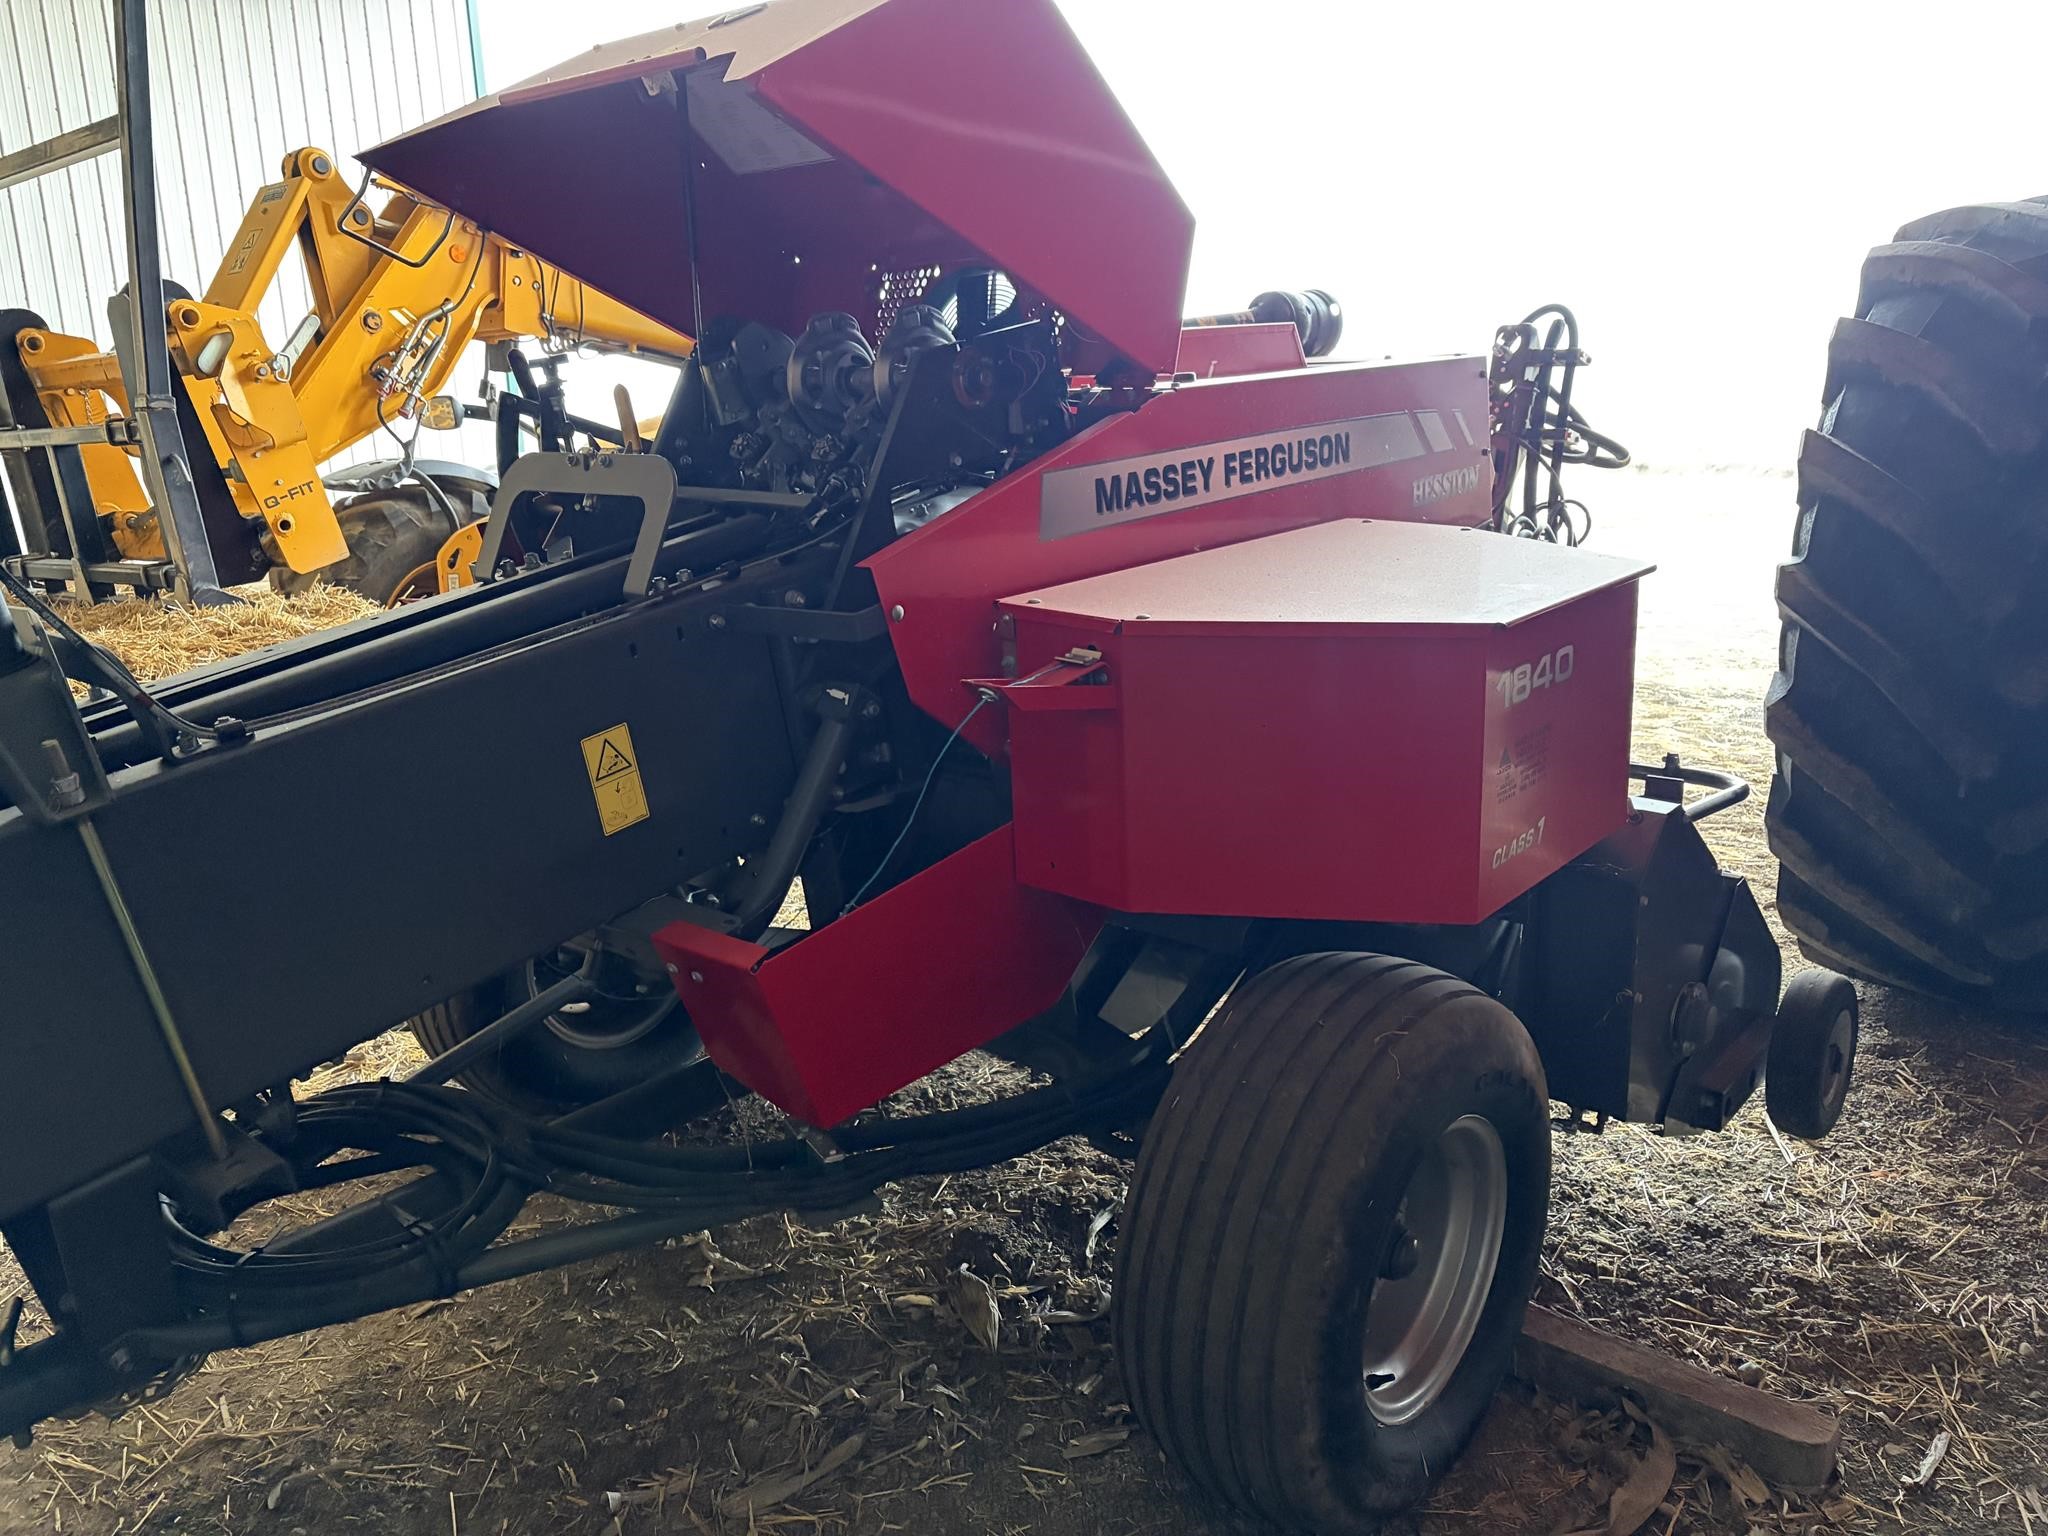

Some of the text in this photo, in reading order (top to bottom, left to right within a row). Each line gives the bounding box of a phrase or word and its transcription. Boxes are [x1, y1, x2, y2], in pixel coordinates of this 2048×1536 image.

[263, 480, 314, 509] Q-FIT
[1094, 431, 1350, 515] MASSEY FERGUSON
[1411, 464, 1481, 507] HESSTON
[1496, 644, 1574, 709] 1840
[1492, 828, 1534, 869] CLASS
